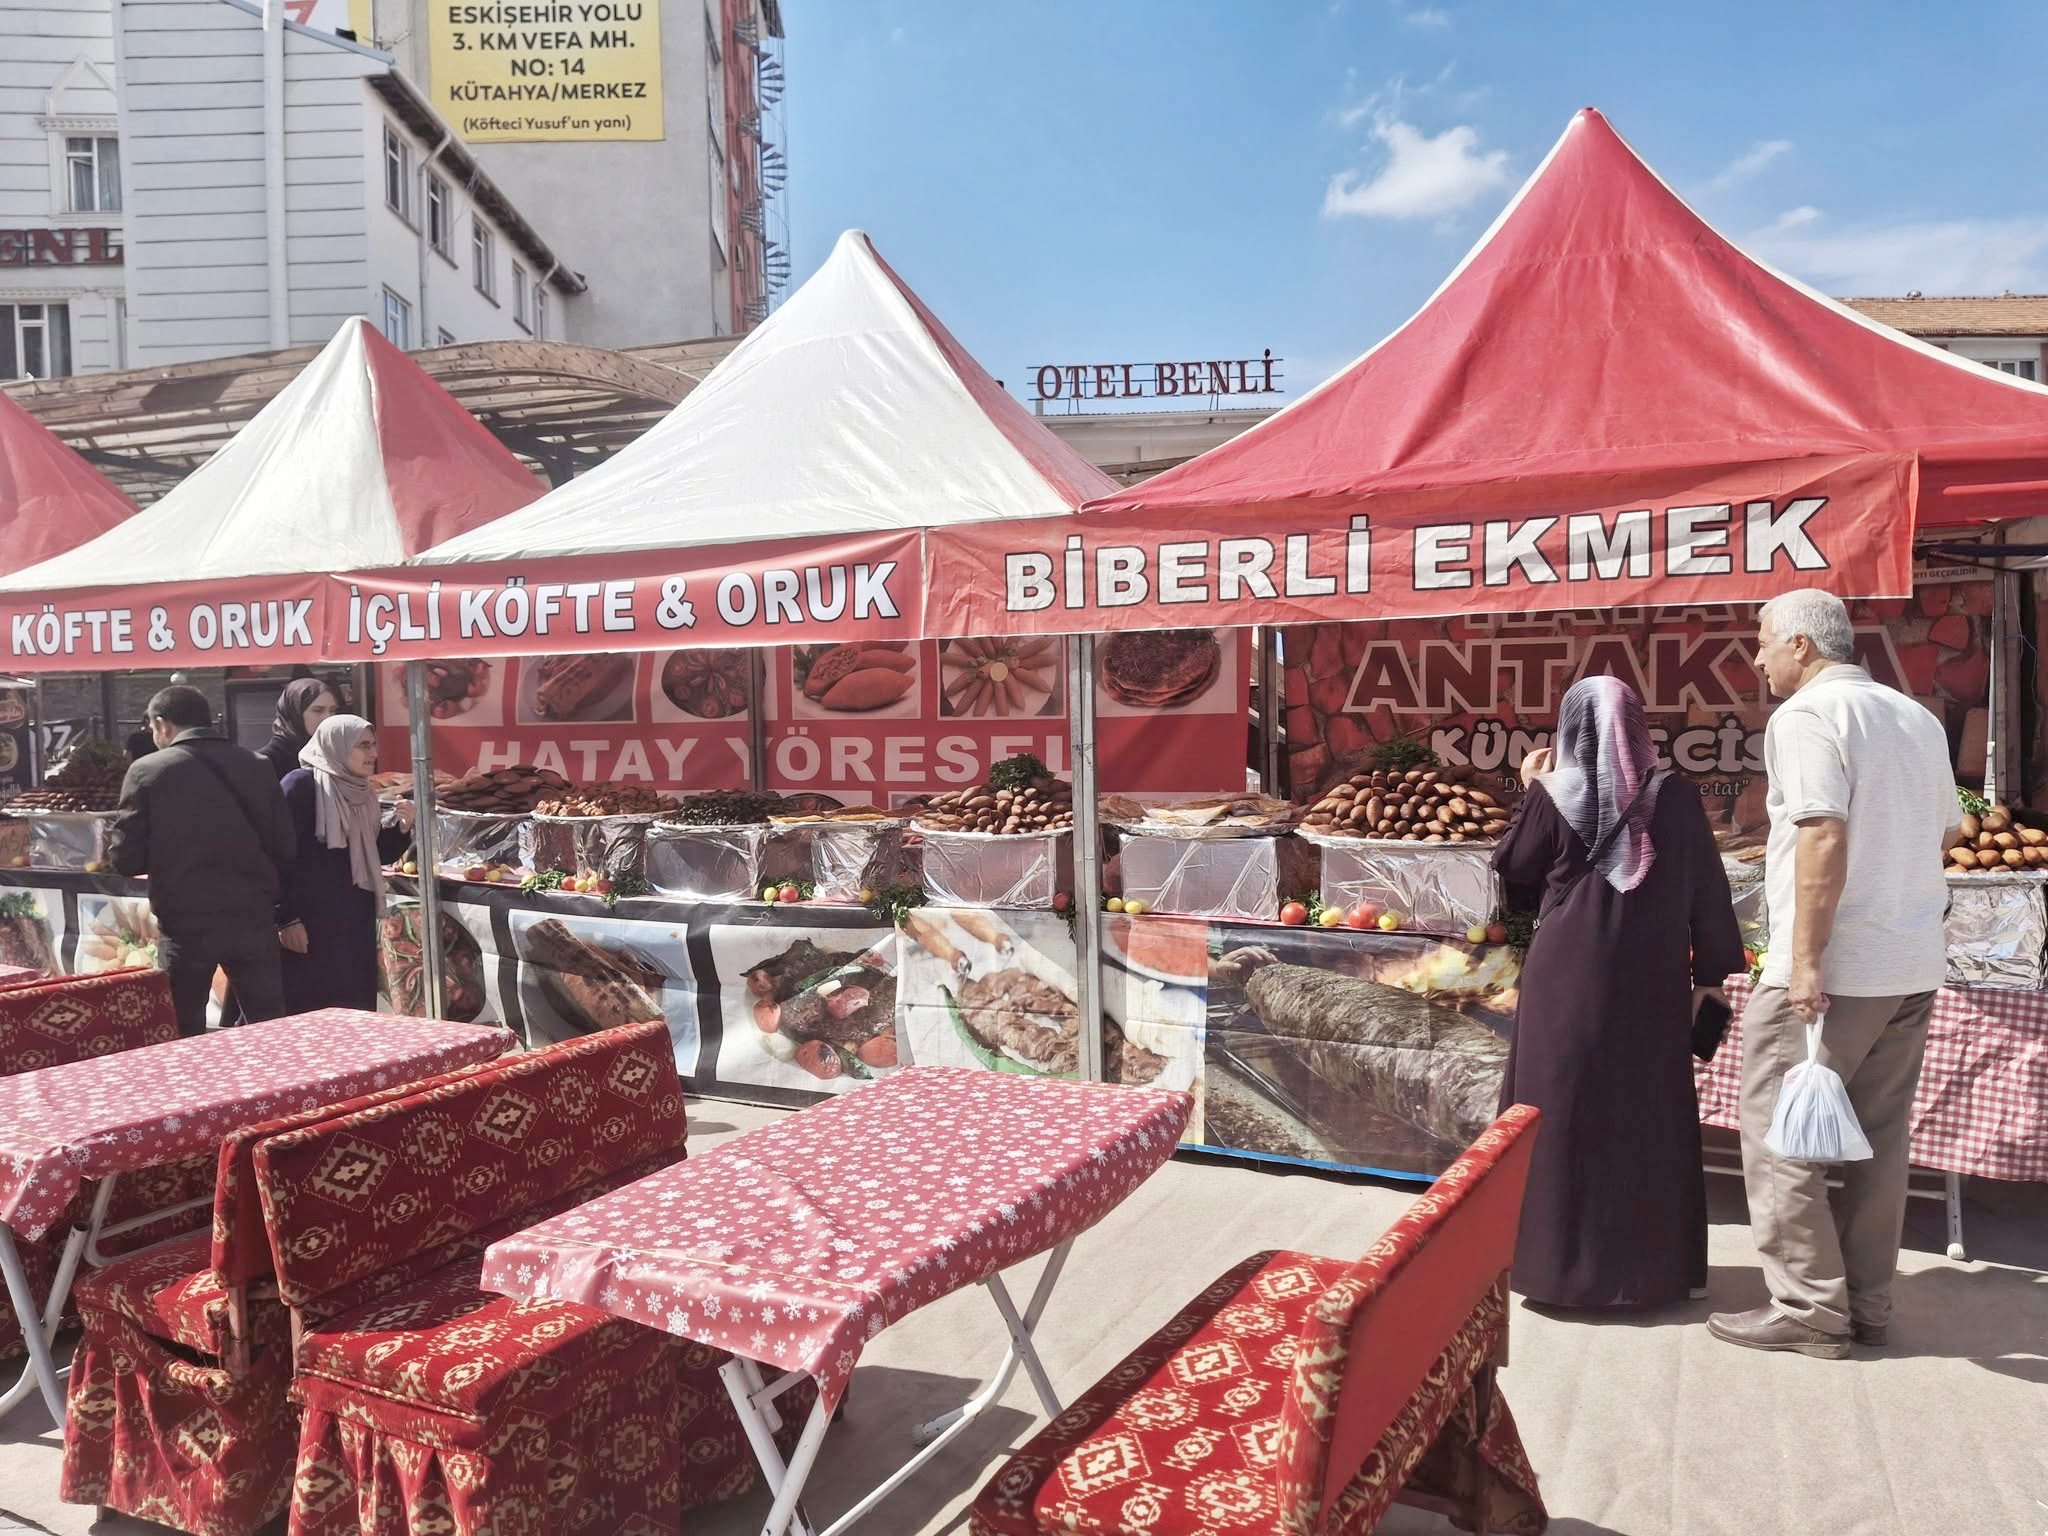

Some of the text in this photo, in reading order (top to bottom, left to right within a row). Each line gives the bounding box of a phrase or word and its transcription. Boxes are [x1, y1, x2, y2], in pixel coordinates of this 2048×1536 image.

[448, 0, 642, 28] ESKİŞEHİR YOLU
[452, 30, 635, 50] 3. KM VEFA MH.
[511, 58, 585, 76] NO: 14
[450, 81, 647, 101] KÜTAHYA/MERKEZ
[463, 115, 632, 133] (Köfteci Yusuf'un yanı)
[1037, 348, 1275, 400] OTEL BENLİ
[1004, 497, 1832, 613] BİBERLİ EKMEK
[347, 561, 901, 655] İÇLİ KÖFTE & ORUK
[11, 598, 314, 656] KÖFTE & ORUK
[477, 738, 701, 782] HATAY
